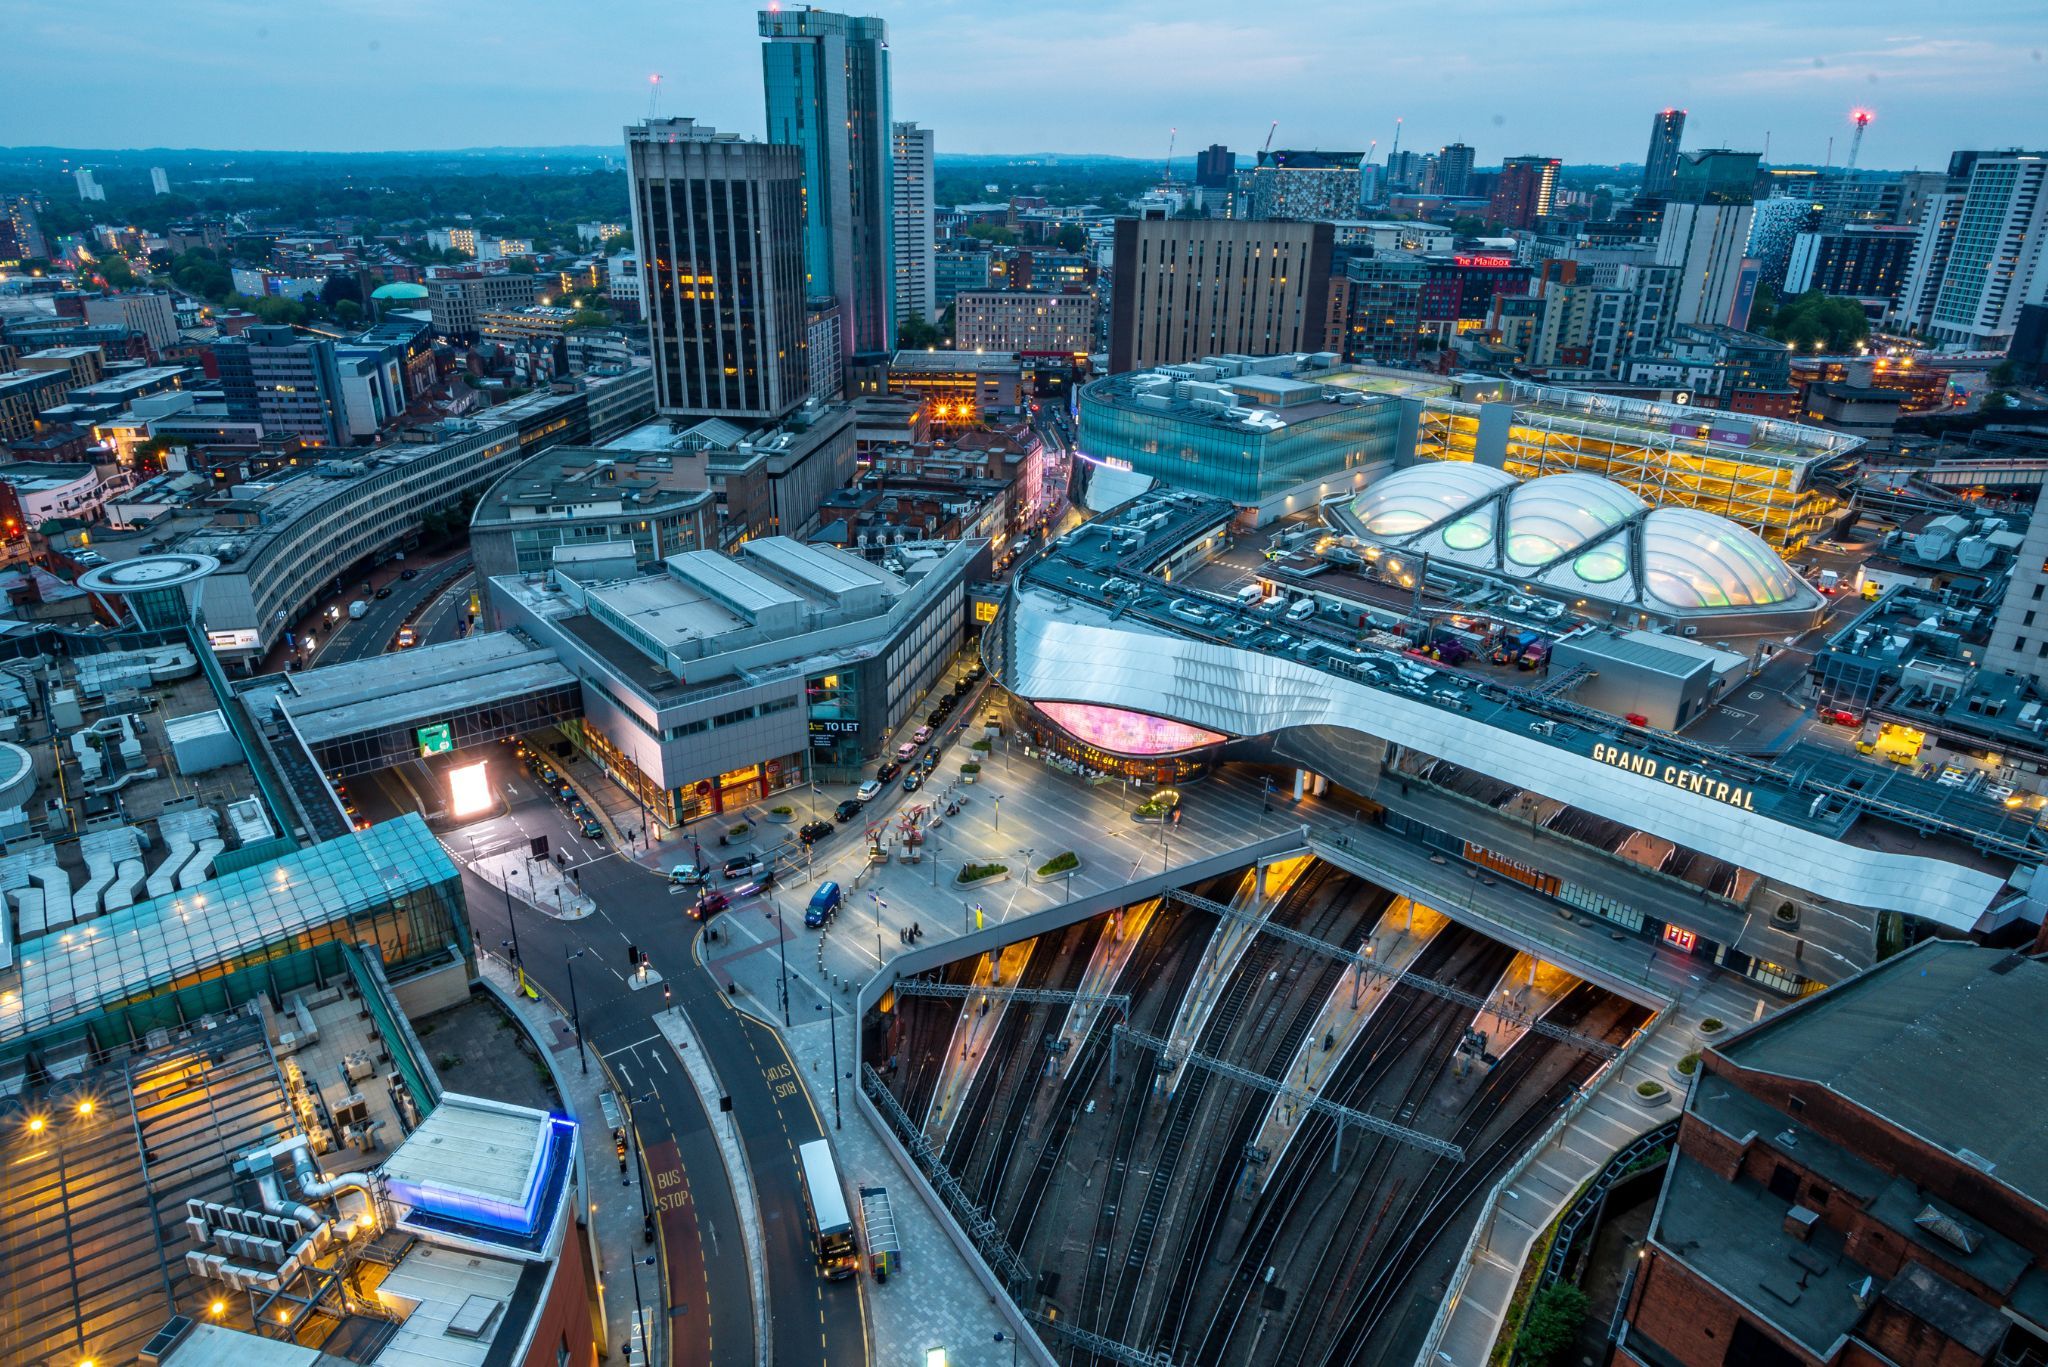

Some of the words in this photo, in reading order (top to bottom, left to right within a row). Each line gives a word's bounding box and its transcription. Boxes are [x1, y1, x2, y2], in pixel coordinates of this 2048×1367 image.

[1473, 256, 1510, 266] Mailbox
[825, 722, 839, 731] TO
[841, 722, 860, 732] LET
[1593, 743, 1657, 778] GRAND
[1663, 766, 1754, 811] CENTRAL
[767, 1064, 791, 1081] STOP
[776, 1081, 797, 1098] BUS
[657, 1169, 681, 1190] BUS
[659, 1190, 688, 1212] STOP
